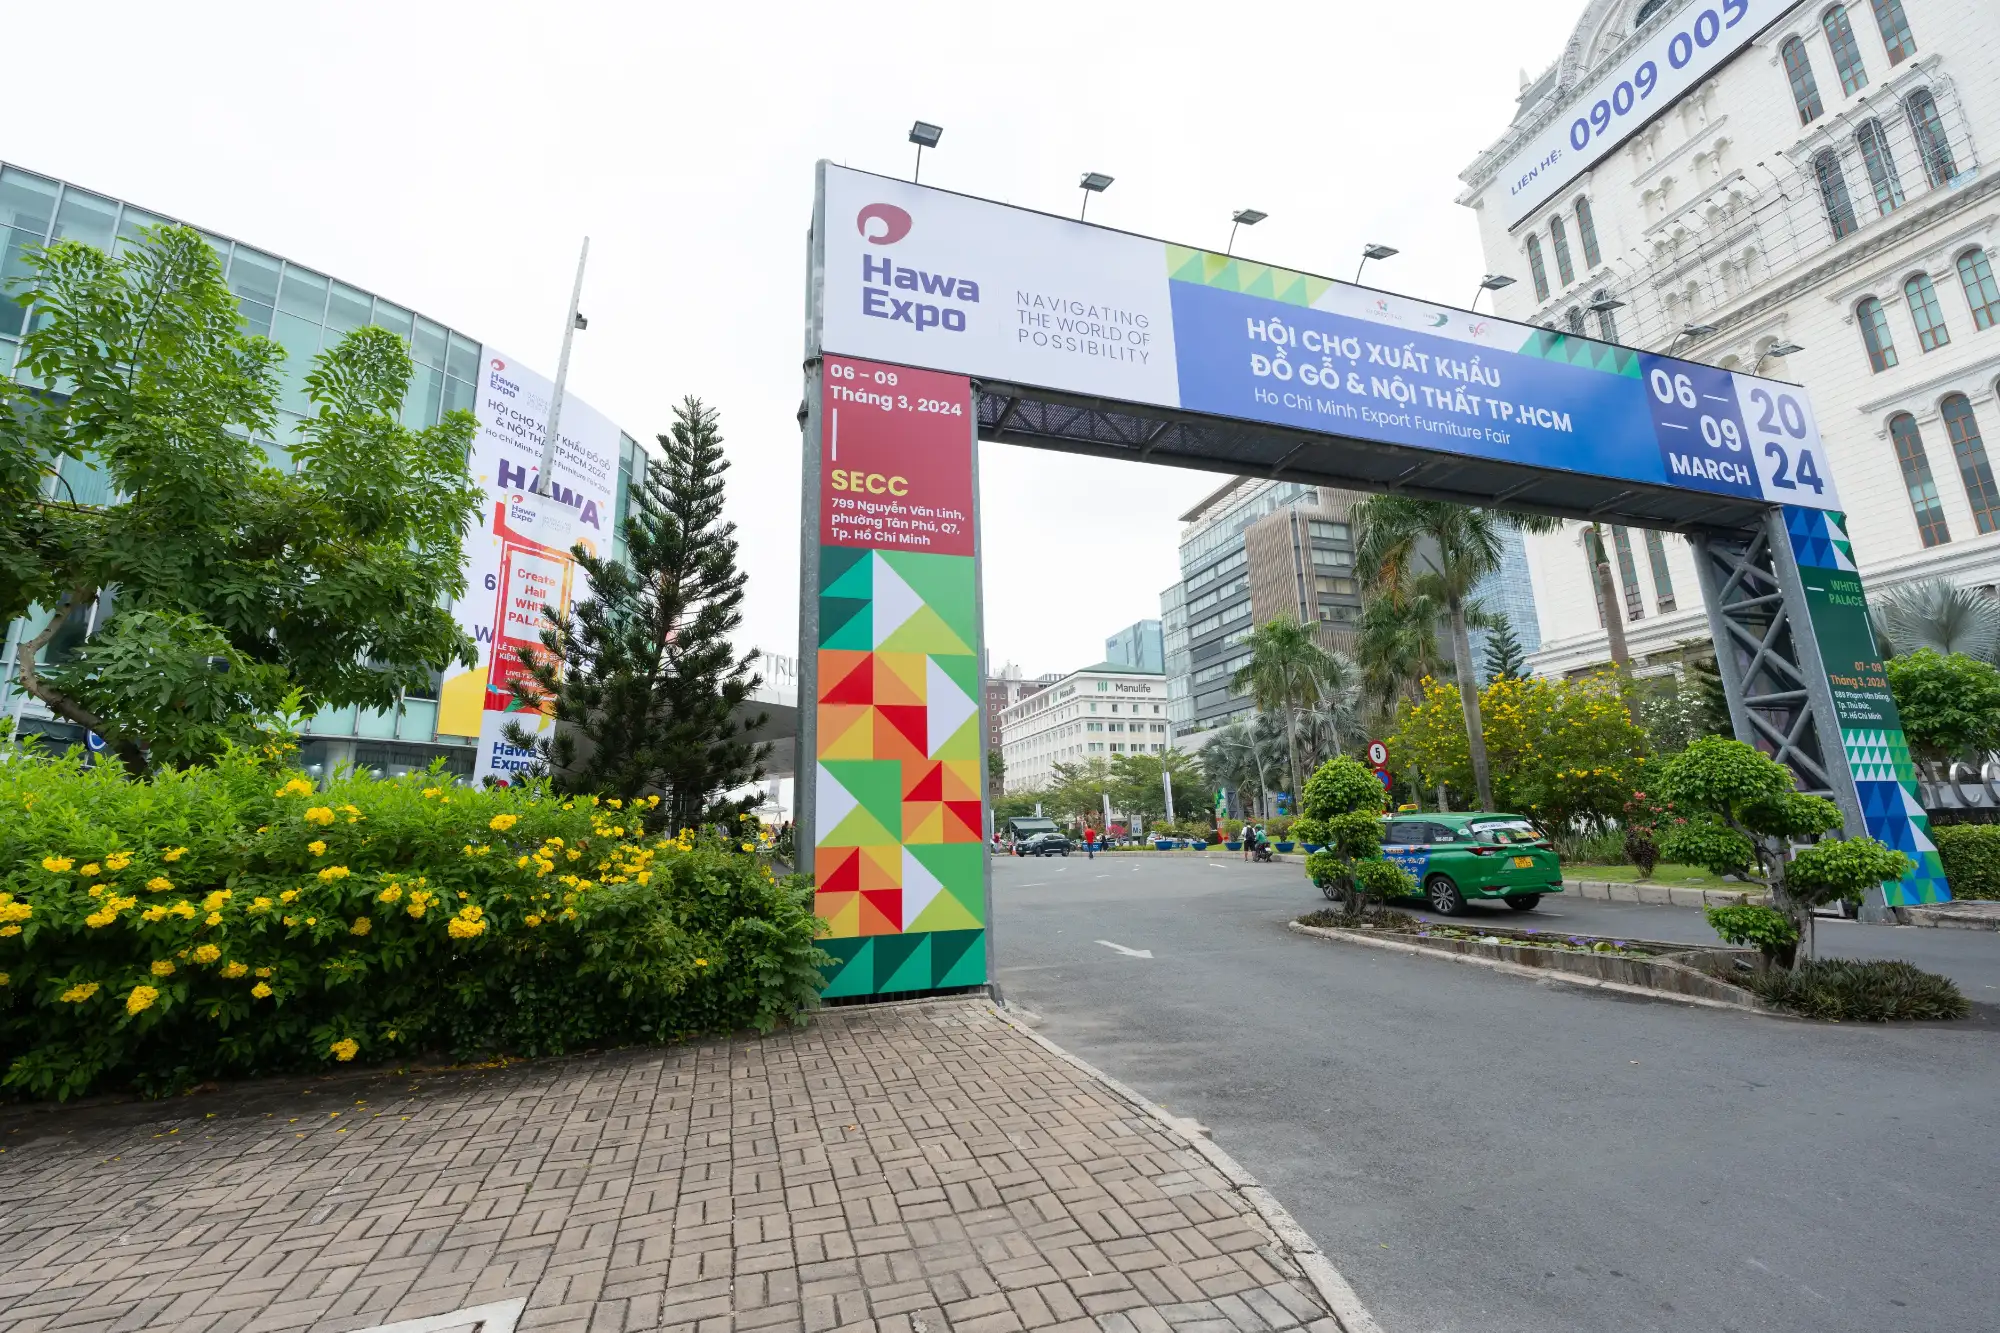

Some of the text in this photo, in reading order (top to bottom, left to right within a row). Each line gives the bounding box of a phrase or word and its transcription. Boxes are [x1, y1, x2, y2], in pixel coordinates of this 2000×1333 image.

[1511, 167, 1538, 196] LIÊN
[1570, 60, 1658, 151] 0909
[862, 254, 980, 303] Hawa
[862, 286, 966, 332] Expo
[1017, 290, 1149, 328] NAVIGATING
[1017, 310, 1150, 346] THE WORLD OF
[1019, 328, 1149, 364] POSSIBILITY
[1302, 330, 1361, 366] CHỢ
[1366, 342, 1430, 374] XUẤT
[1434, 355, 1501, 388] KHẨU
[490, 371, 520, 392] Hawa
[830, 364, 855, 380] 06
[874, 371, 898, 386] 09
[490, 380, 516, 398] Expo
[830, 385, 962, 416] Tháng 3, 2024
[1250, 346, 1572, 432] ĐỒ GỖ & NỘI THẤT TP.HCM
[1650, 368, 1697, 409] 06
[488, 399, 508, 416] HỘI
[510, 410, 534, 430] CHỢ
[1254, 387, 1510, 444] Ho Chi Minh Export Furniture Fair
[1750, 388, 1806, 440] 20
[499, 434, 512, 444] Chi
[514, 440, 534, 454] Minh
[1700, 414, 1742, 452] 09
[496, 416, 504, 428] &
[507, 422, 526, 438] NỘI
[588, 464, 606, 480] 2024
[1668, 452, 1752, 486] MARCH
[1764, 442, 1824, 495] 24
[832, 469, 908, 496] SECC
[511, 510, 534, 523] Expo
[512, 504, 536, 518] Hawa
[832, 498, 966, 521] 799 Nguyễn Văn Linh,
[832, 513, 960, 534] phường Tân Phú, Q7,
[832, 528, 931, 546] Tp. Hồ Chí Minh
[518, 568, 556, 586] Create
[1830, 579, 1860, 593] WHITE
[524, 584, 546, 598] Hall
[1828, 594, 1864, 606] PALACE
[1854, 662, 1864, 671] 07
[1116, 684, 1151, 692] Manulife
[1830, 674, 1858, 689] Tháng
[1866, 677, 1886, 688] 2024
[491, 756, 530, 772] Expo
[1375, 748, 1380, 760] 5
